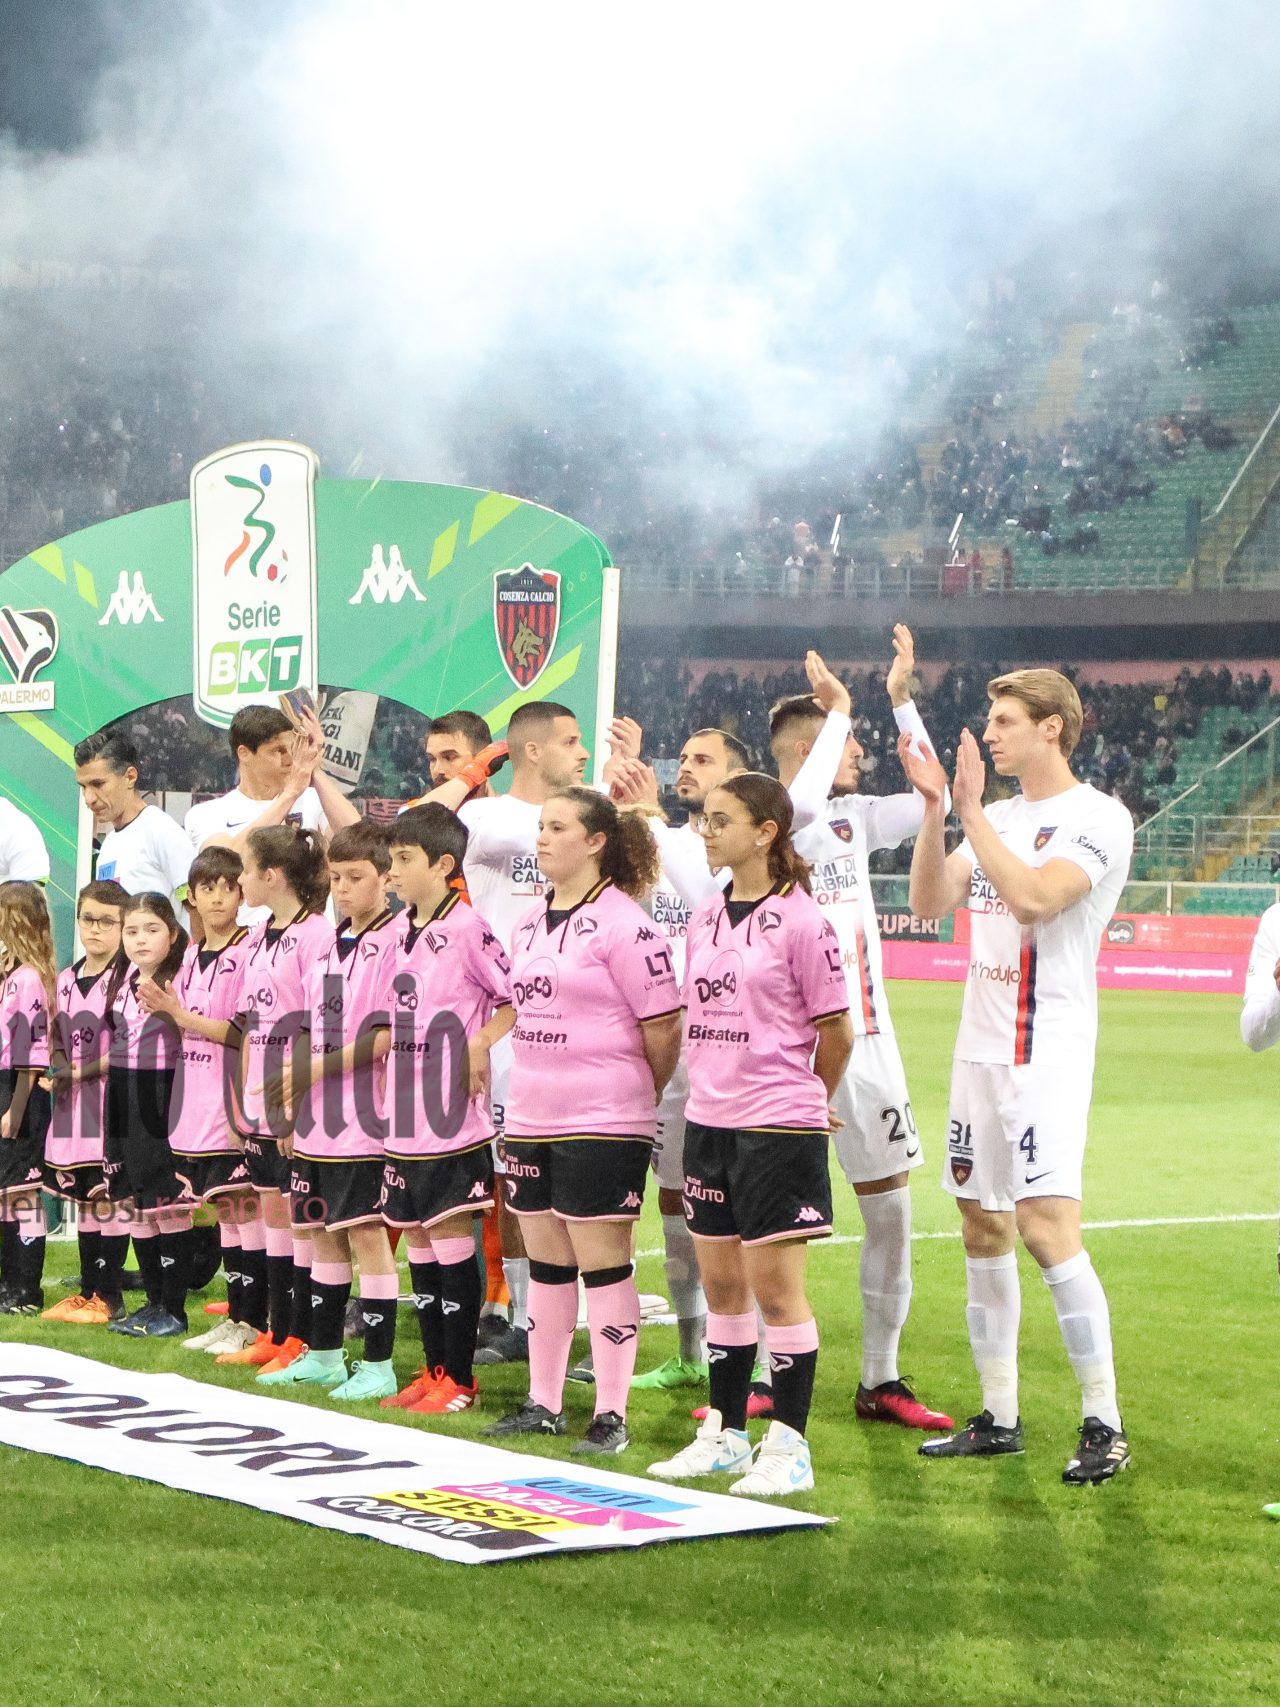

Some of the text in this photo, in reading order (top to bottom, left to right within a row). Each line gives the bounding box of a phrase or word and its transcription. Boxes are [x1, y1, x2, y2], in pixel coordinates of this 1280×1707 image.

[499, 591, 555, 603] COSENZA CALCIO
[228, 600, 281, 631] Serie
[208, 639, 302, 692] BKT
[512, 857, 540, 870] SAL
[645, 950, 672, 978] LT
[513, 976, 553, 1007] Decò
[249, 1032, 289, 1046] saten
[688, 1024, 750, 1043] Bisaten
[1019, 1123, 1039, 1166] 4
[395, 1491, 559, 1528] STESSI
[458, 1485, 604, 1516] DAGLI
[524, 1480, 653, 1508] UNITI
[325, 1497, 497, 1538] COLORI
